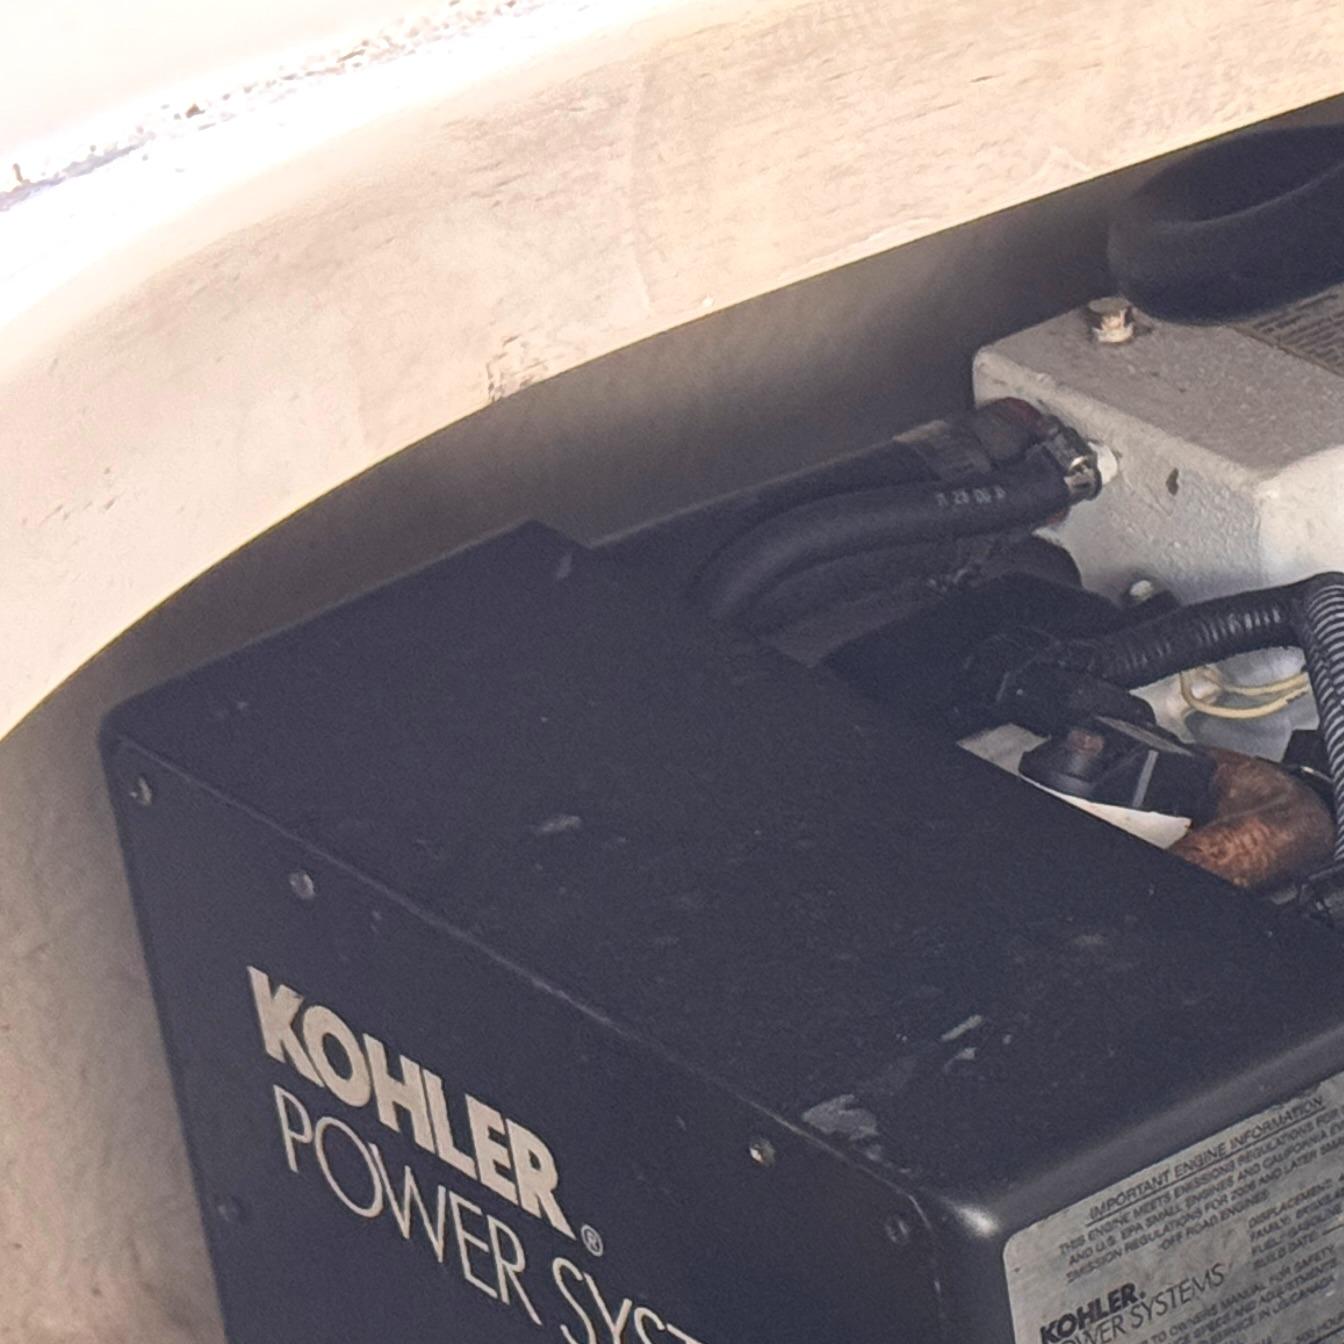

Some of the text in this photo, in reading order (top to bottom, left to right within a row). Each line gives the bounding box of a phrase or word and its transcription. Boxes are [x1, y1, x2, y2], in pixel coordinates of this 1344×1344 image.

[273, 1084, 542, 1325] POWER
[1089, 1094, 1324, 1221] IMPORTANT ENGINE INFORMATION
[1128, 1259, 1226, 1332] SYSTEMS
